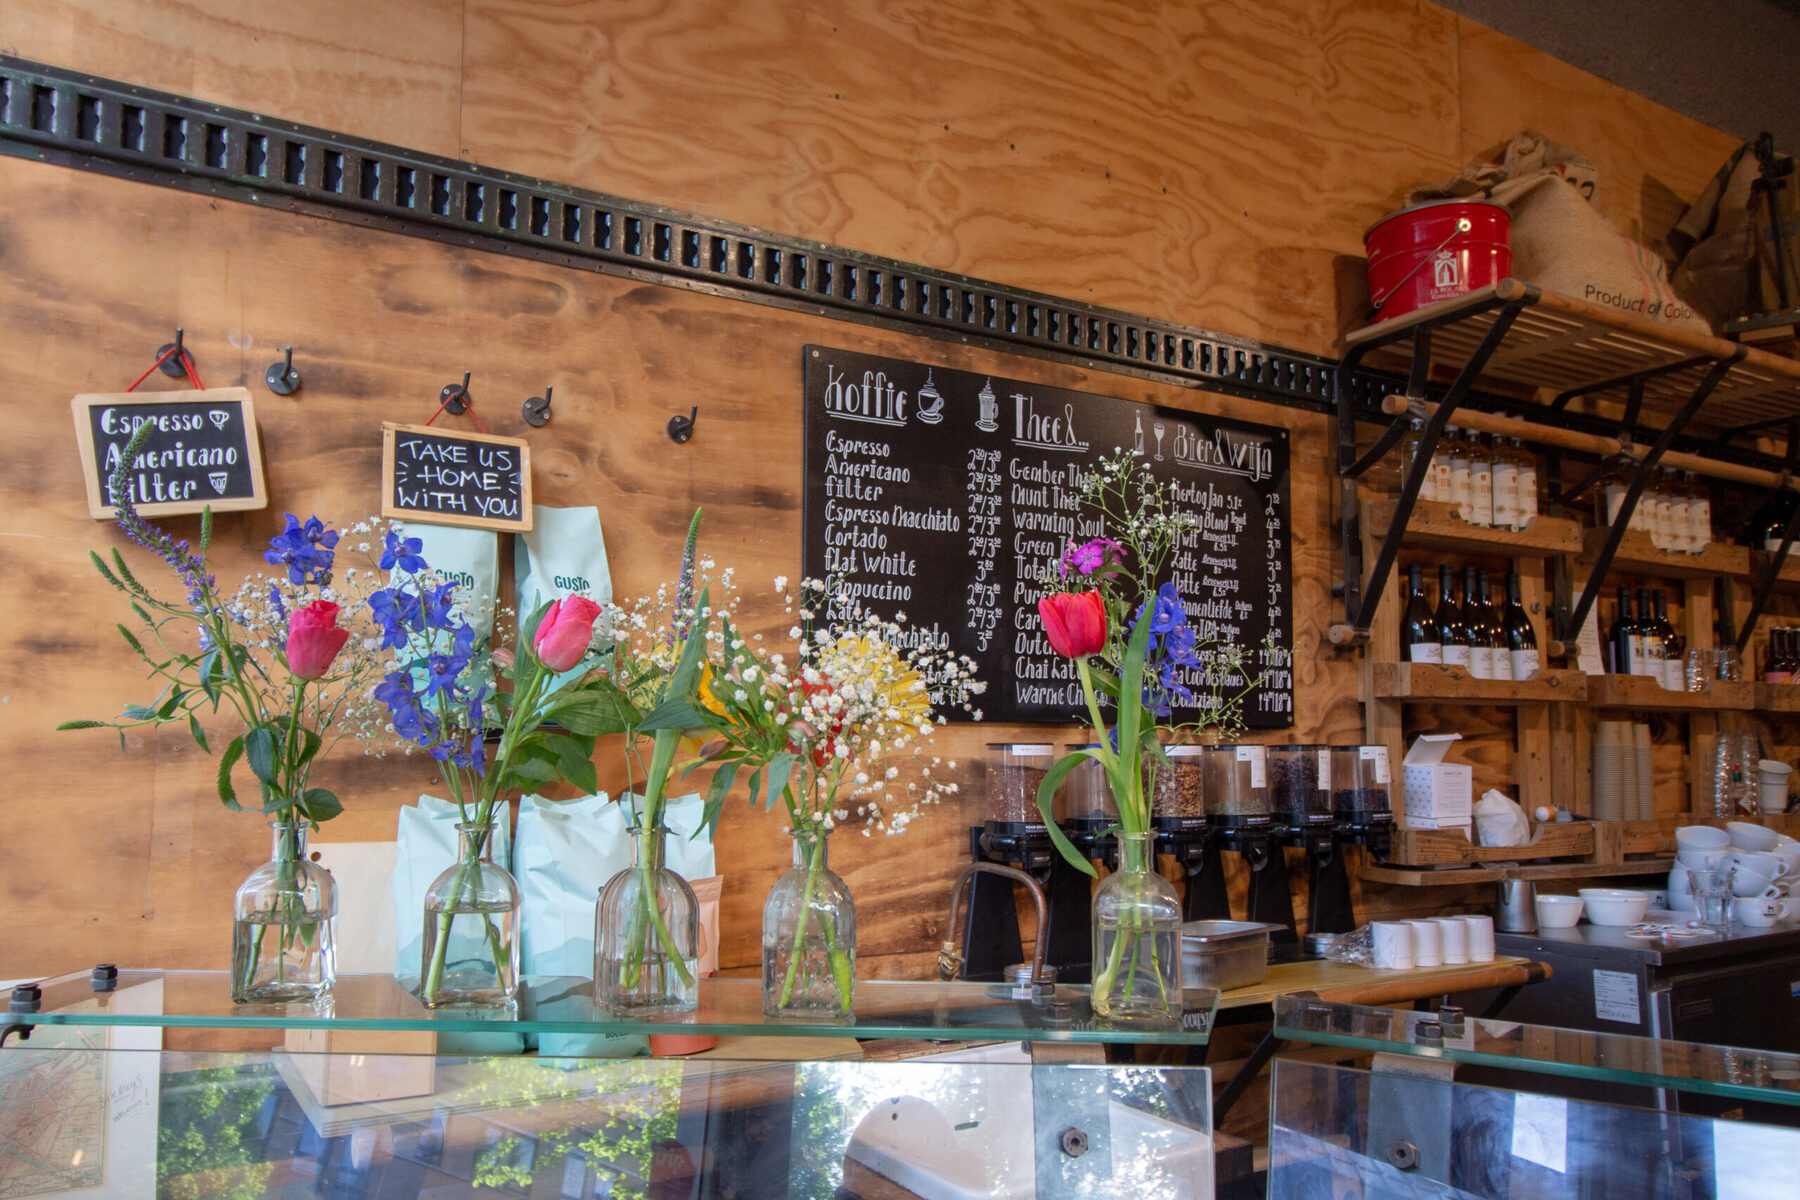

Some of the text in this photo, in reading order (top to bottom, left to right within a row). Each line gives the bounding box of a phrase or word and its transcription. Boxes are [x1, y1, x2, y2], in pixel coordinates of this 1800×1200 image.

[1585, 284, 1643, 313] Product
[1647, 301, 1662, 316] of
[824, 364, 908, 421] Koffie
[400, 440, 512, 471] TAKE US
[826, 430, 890, 460] Espresso
[416, 465, 501, 492] HOME
[824, 453, 910, 483] Americano
[1009, 458, 1065, 485] Gember
[474, 495, 518, 517] YOU
[825, 500, 889, 529] Espresso
[892, 504, 960, 532] Macchiato
[825, 524, 887, 550] Cortado
[1077, 513, 1106, 538] Soul
[1014, 532, 1055, 557] Green
[1170, 549, 1198, 572] Zatte
[554, 575, 590, 592] GUSTO
[825, 574, 912, 605] Cappuccino
[1180, 599, 1232, 619] annenliefde
[1016, 656, 1048, 679] Chai
